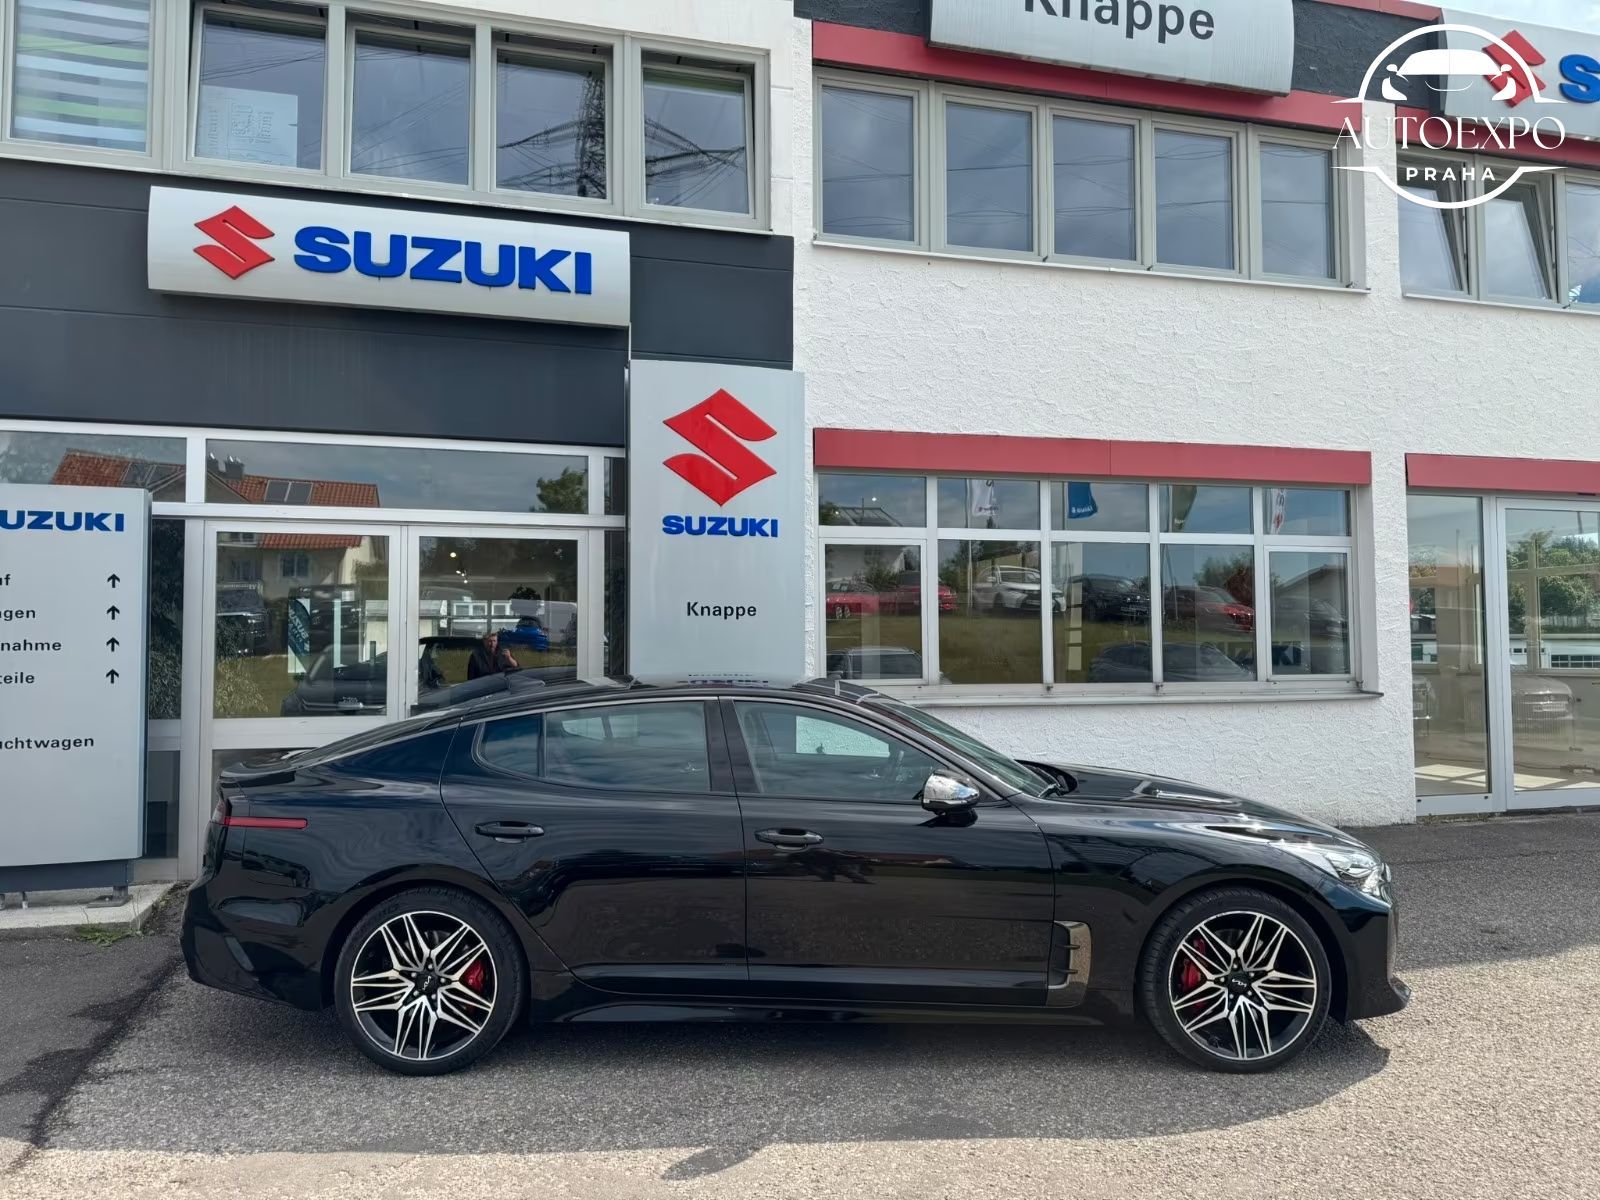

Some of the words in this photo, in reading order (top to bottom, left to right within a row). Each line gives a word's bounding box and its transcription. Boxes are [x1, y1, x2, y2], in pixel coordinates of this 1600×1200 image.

[294, 226, 592, 295] SUZUKI
[0, 510, 125, 532] UZUKI
[662, 515, 778, 537] SUZUKI
[687, 602, 757, 620] Knappe
[0, 737, 95, 751] chtwagen
